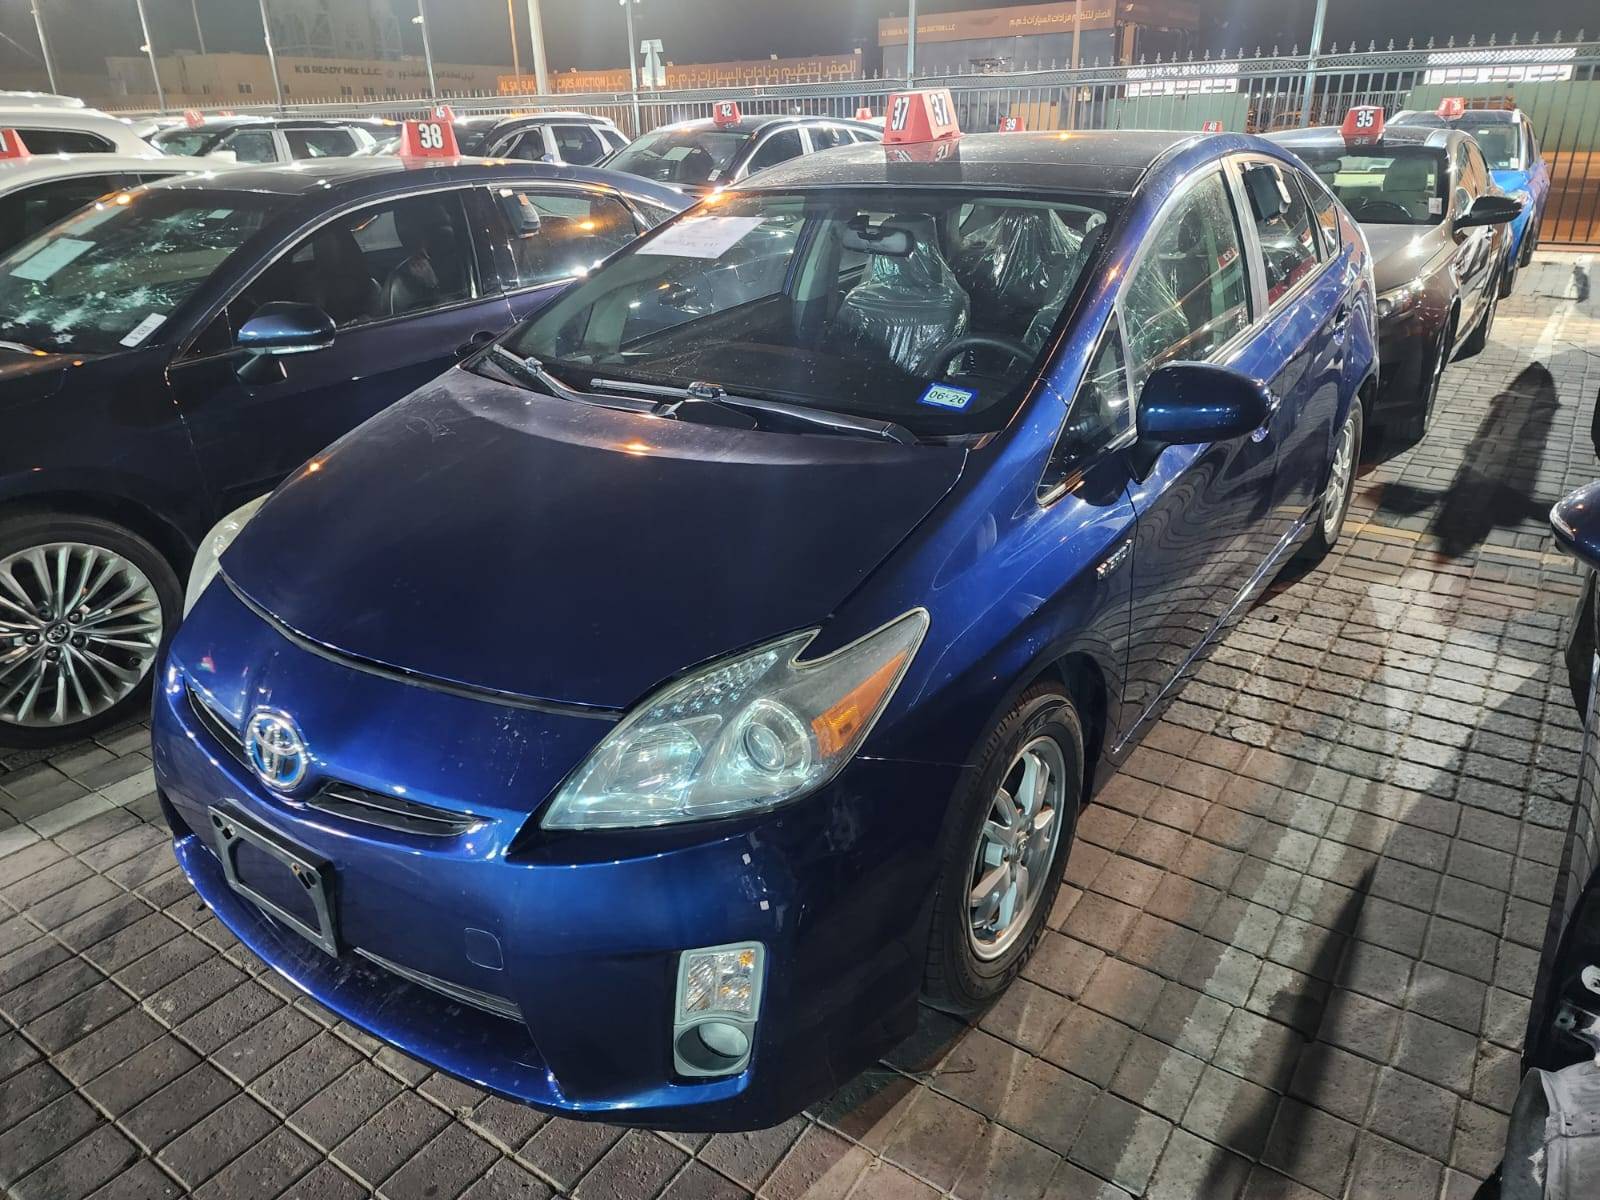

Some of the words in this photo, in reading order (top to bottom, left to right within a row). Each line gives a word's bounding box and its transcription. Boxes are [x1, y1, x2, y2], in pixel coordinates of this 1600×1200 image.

[699, 67, 742, 84] السيارات
[743, 65, 779, 80] مزادات
[781, 61, 822, 80] لتنظيم
[823, 60, 857, 77] الصقر
[891, 97, 910, 131] 37
[929, 94, 951, 127] 37
[1356, 110, 1375, 128] 35
[418, 122, 444, 149] 38
[929, 390, 946, 400] 06
[949, 394, 967, 405] 26
